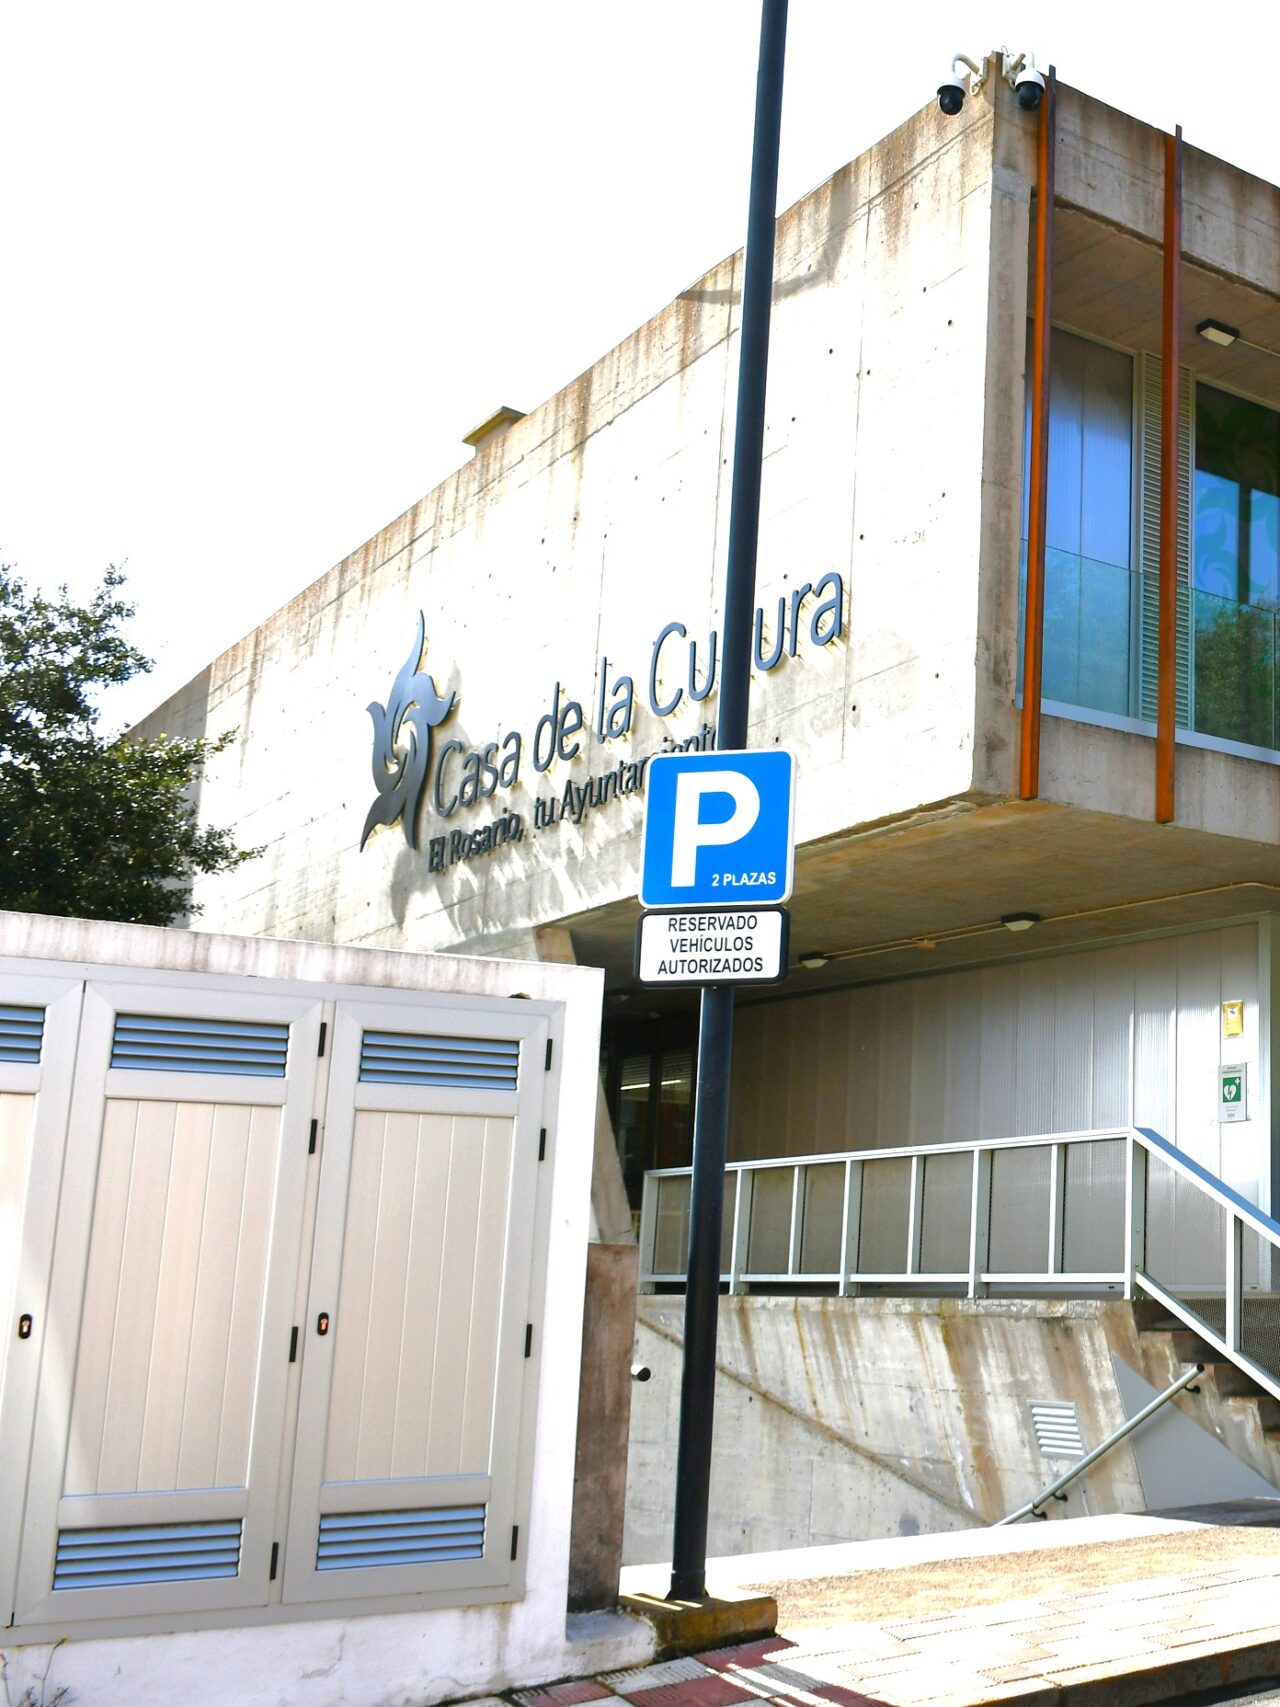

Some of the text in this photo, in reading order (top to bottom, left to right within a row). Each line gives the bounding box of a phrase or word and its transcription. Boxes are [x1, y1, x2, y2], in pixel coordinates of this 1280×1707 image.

[433, 572, 843, 818] Casa de la Cuura
[428, 836, 446, 873] El
[450, 807, 524, 866] Rosario,
[534, 796, 556, 830] tu
[670, 770, 761, 888] P
[711, 872, 777, 887] 2 PLAZAS
[668, 914, 758, 932] RESERVADO
[670, 934, 753, 953] VEHÍCULOS
[658, 957, 763, 975] AUTORIZADOS
